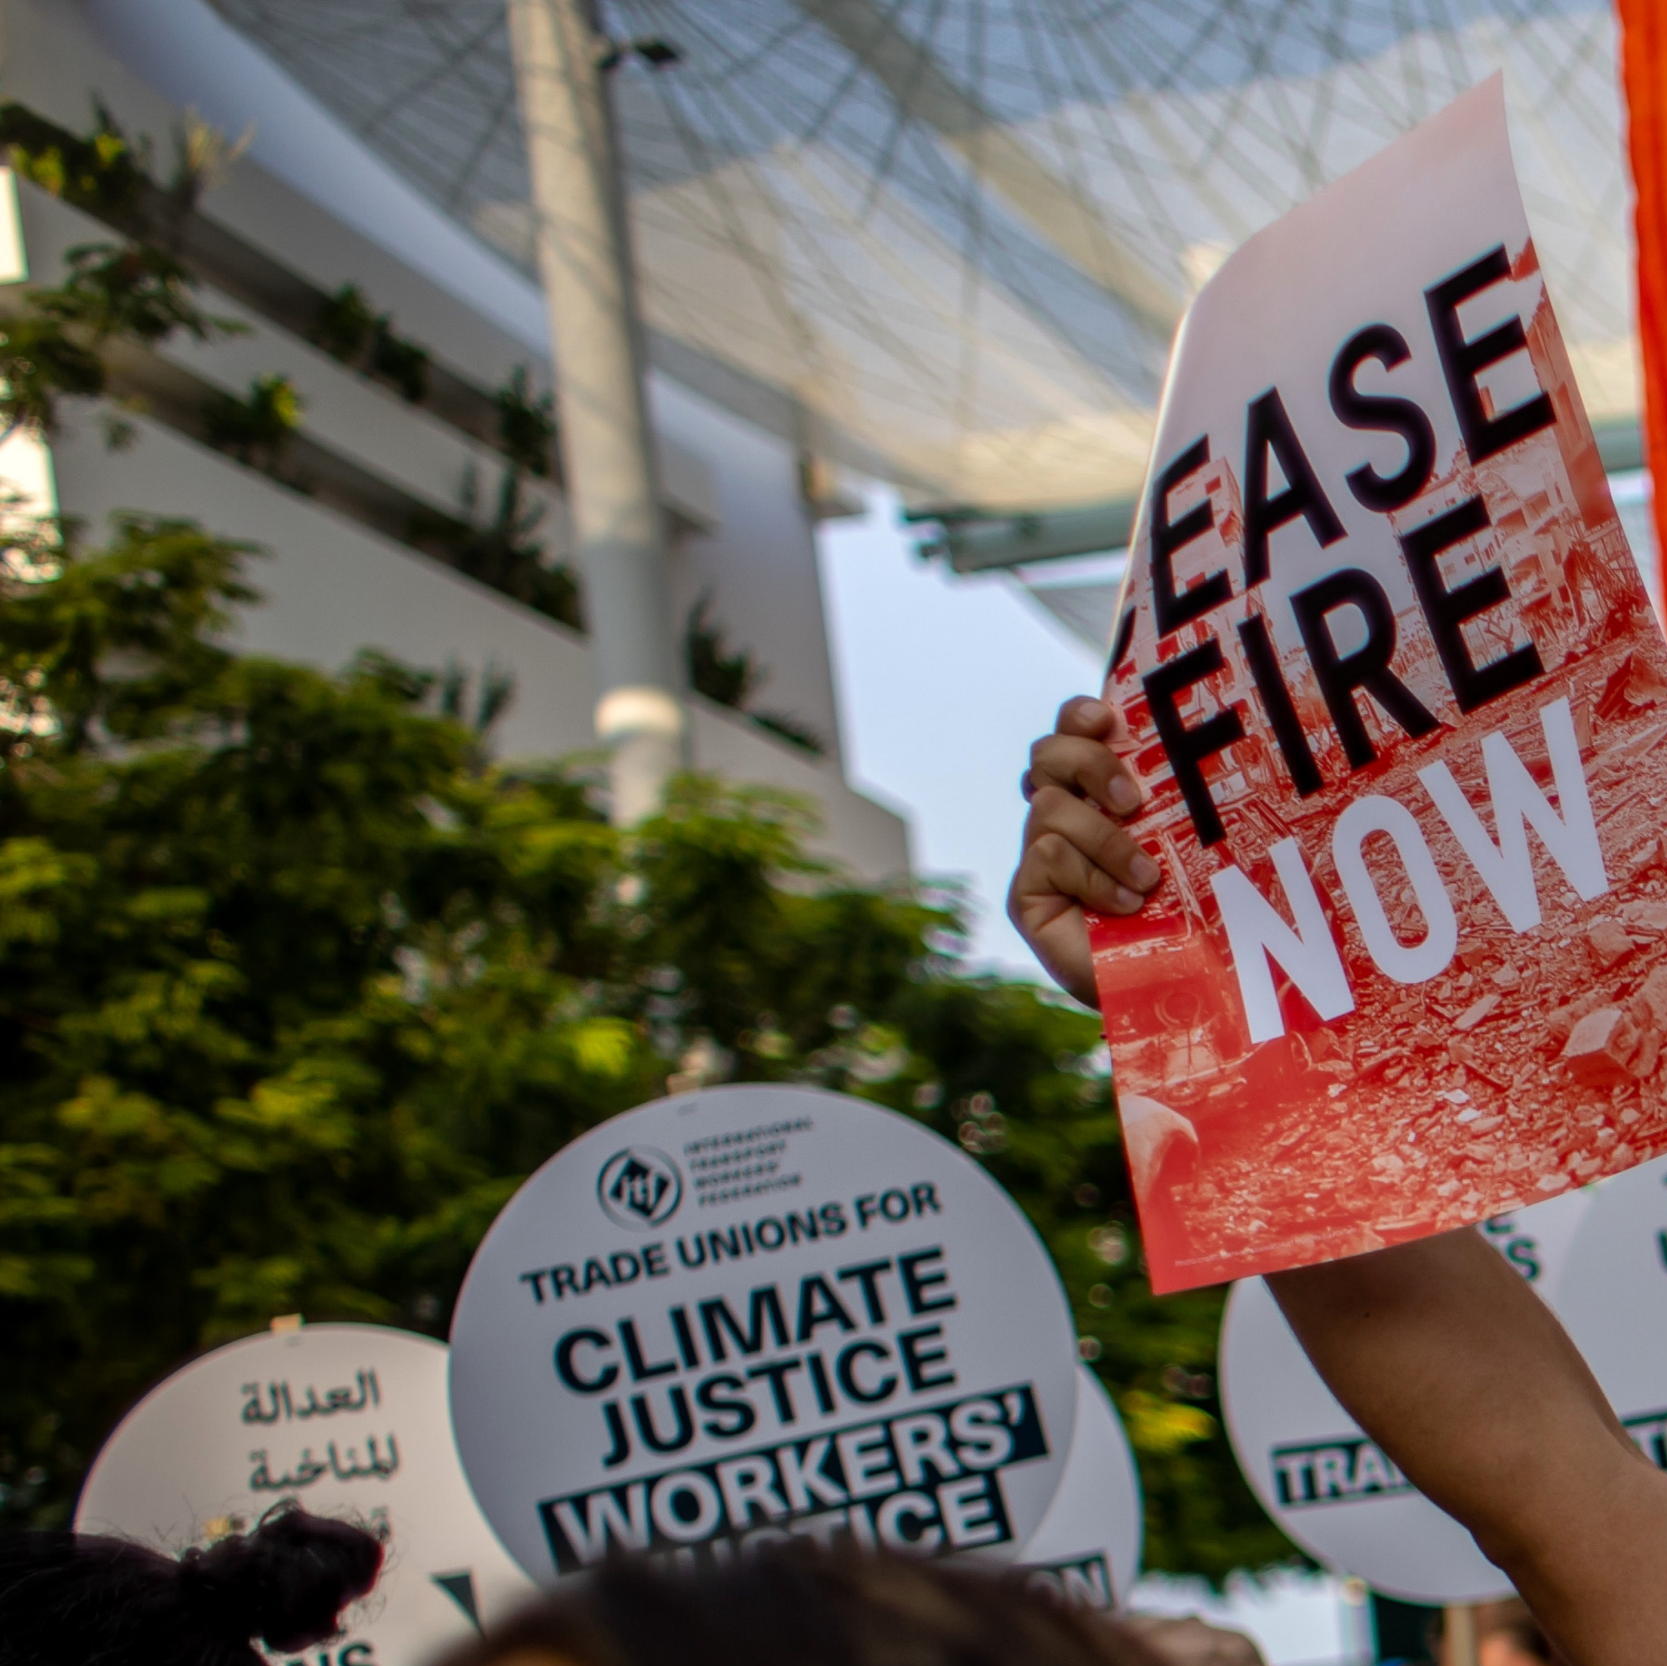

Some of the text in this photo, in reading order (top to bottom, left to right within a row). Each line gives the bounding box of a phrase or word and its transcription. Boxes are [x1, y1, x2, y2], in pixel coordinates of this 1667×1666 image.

[1140, 496, 1546, 849] FIRE
[1209, 695, 1611, 1046] NOW
[520, 1181, 942, 1305] TRADE UNIONS FOR
[553, 1245, 958, 1395] CLIMATE
[241, 1368, 380, 1425] العدالة
[600, 1324, 958, 1468] JUSTICE
